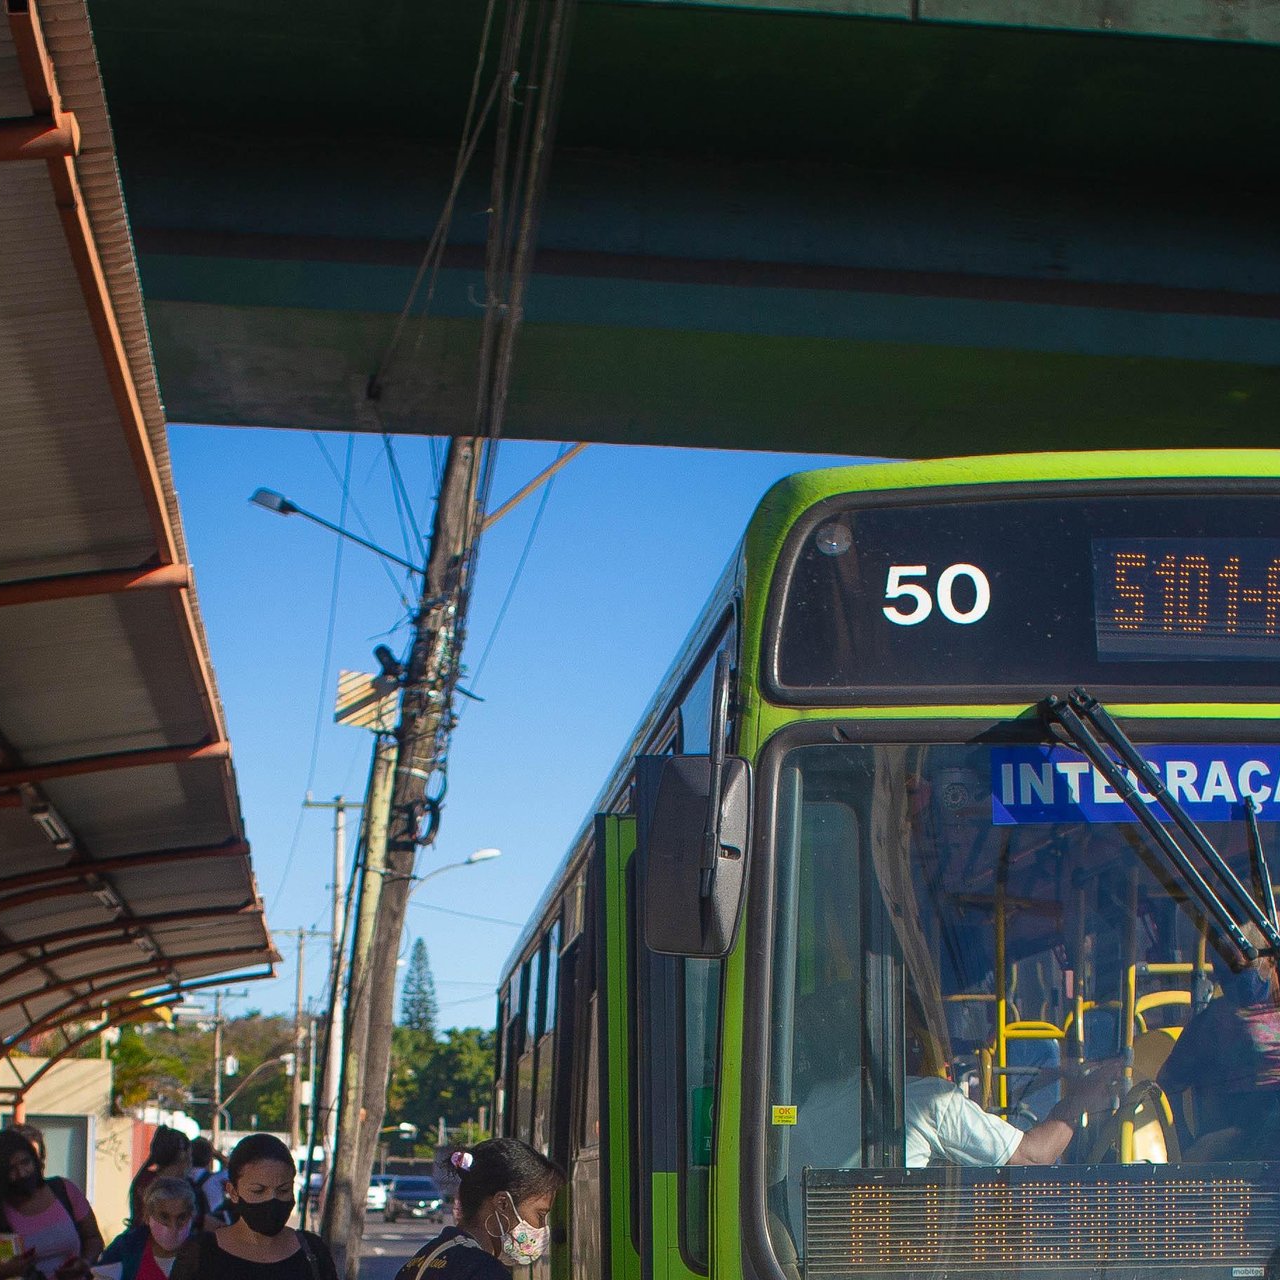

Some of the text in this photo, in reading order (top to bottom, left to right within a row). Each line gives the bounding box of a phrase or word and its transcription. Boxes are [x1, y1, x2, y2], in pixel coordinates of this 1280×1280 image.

[882, 563, 991, 626] 50
[778, 1107, 792, 1115] OK
[851, 1178, 1251, 1262] AJ RENNER
